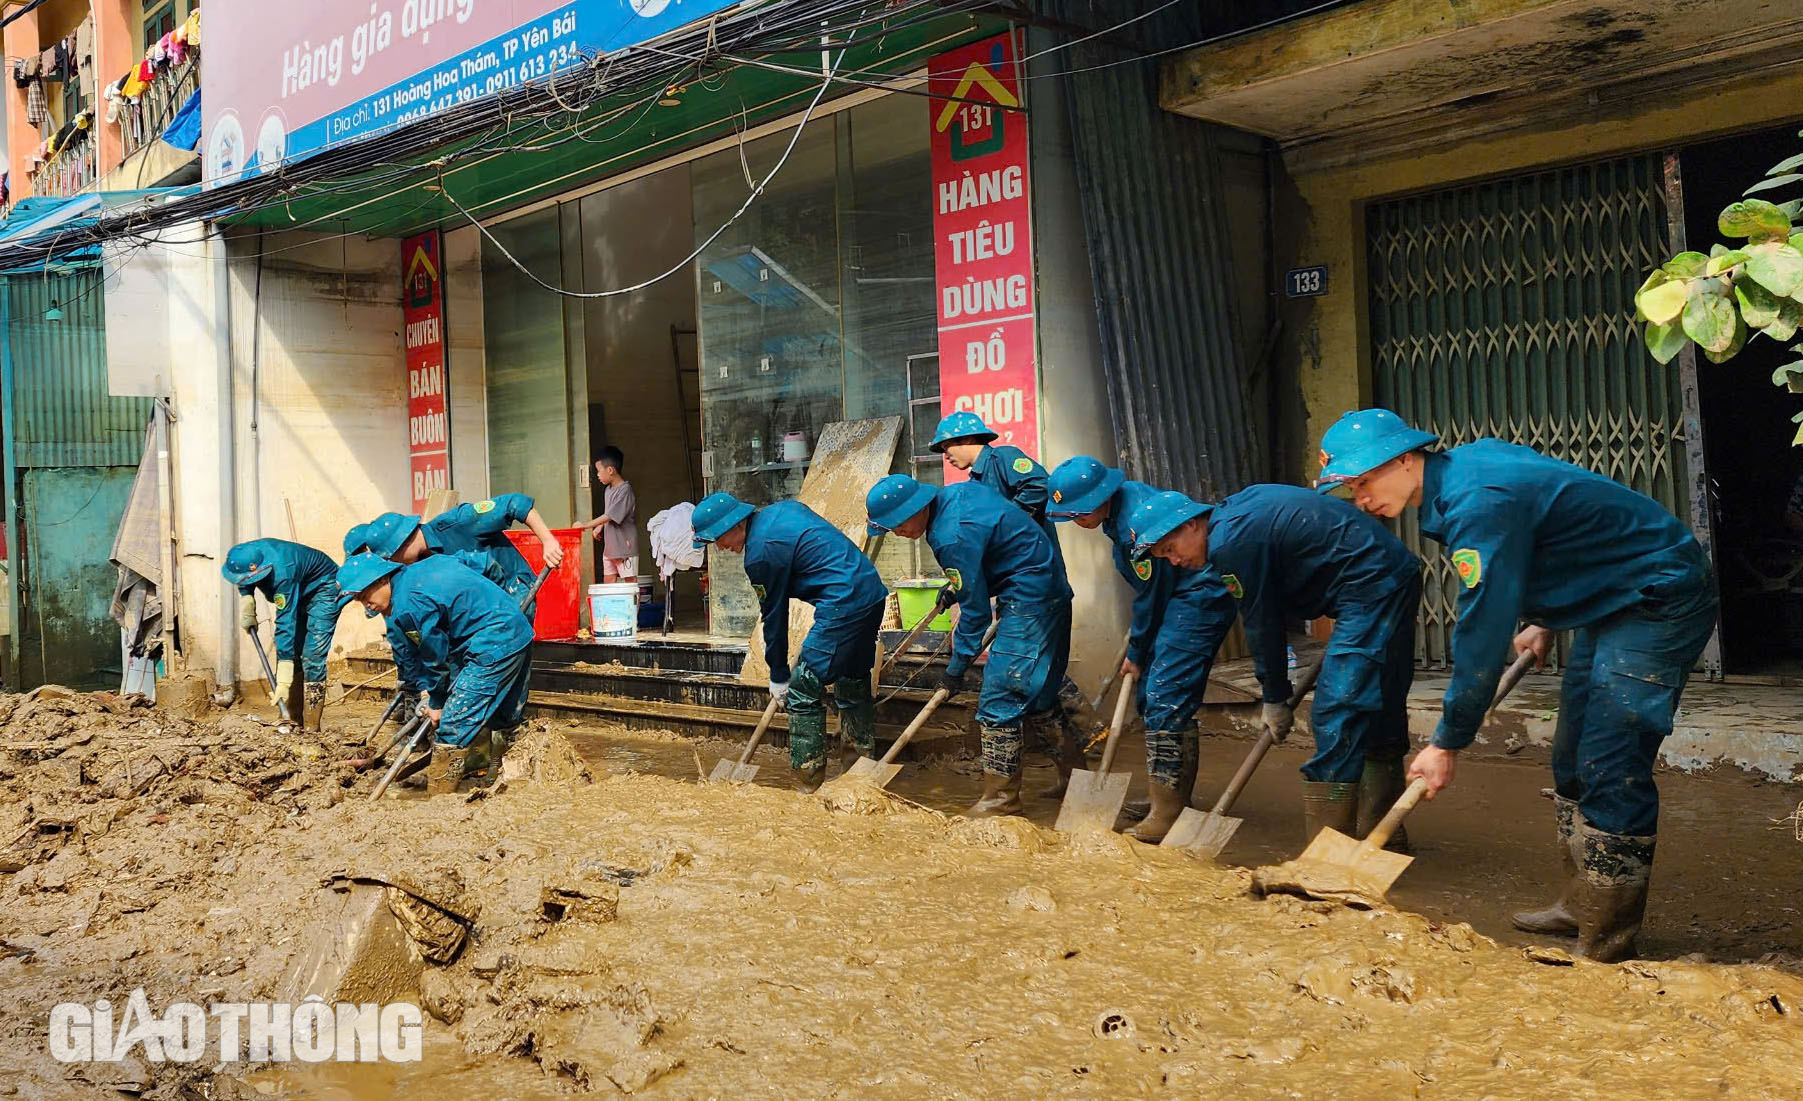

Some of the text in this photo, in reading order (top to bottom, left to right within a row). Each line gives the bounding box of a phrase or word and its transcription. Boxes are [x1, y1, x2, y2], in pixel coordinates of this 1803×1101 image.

[282, 35, 344, 98] Hàng
[351, 3, 392, 75] gia
[520, 55, 545, 81] 613
[549, 40, 577, 71] 234
[333, 115, 351, 136] Địa
[373, 95, 391, 118] 131
[393, 81, 431, 109] Hoàng
[434, 68, 458, 92] Hoa
[460, 51, 500, 79] Thám,
[502, 38, 519, 60] TP
[522, 27, 549, 52] Yên
[553, 10, 577, 40] Bái
[960, 100, 992, 132] 131
[938, 165, 1023, 214] HÀNG
[948, 219, 1014, 265] TIÊU
[414, 271, 429, 290] 131
[942, 274, 1028, 319] DÙNG
[1294, 270, 1321, 294] 133
[406, 313, 440, 349] CHUYÊN
[965, 327, 1006, 375] ĐỒ
[409, 361, 441, 399] BÁN
[410, 408, 445, 446] BUÔN
[414, 464, 446, 501] BÁN
